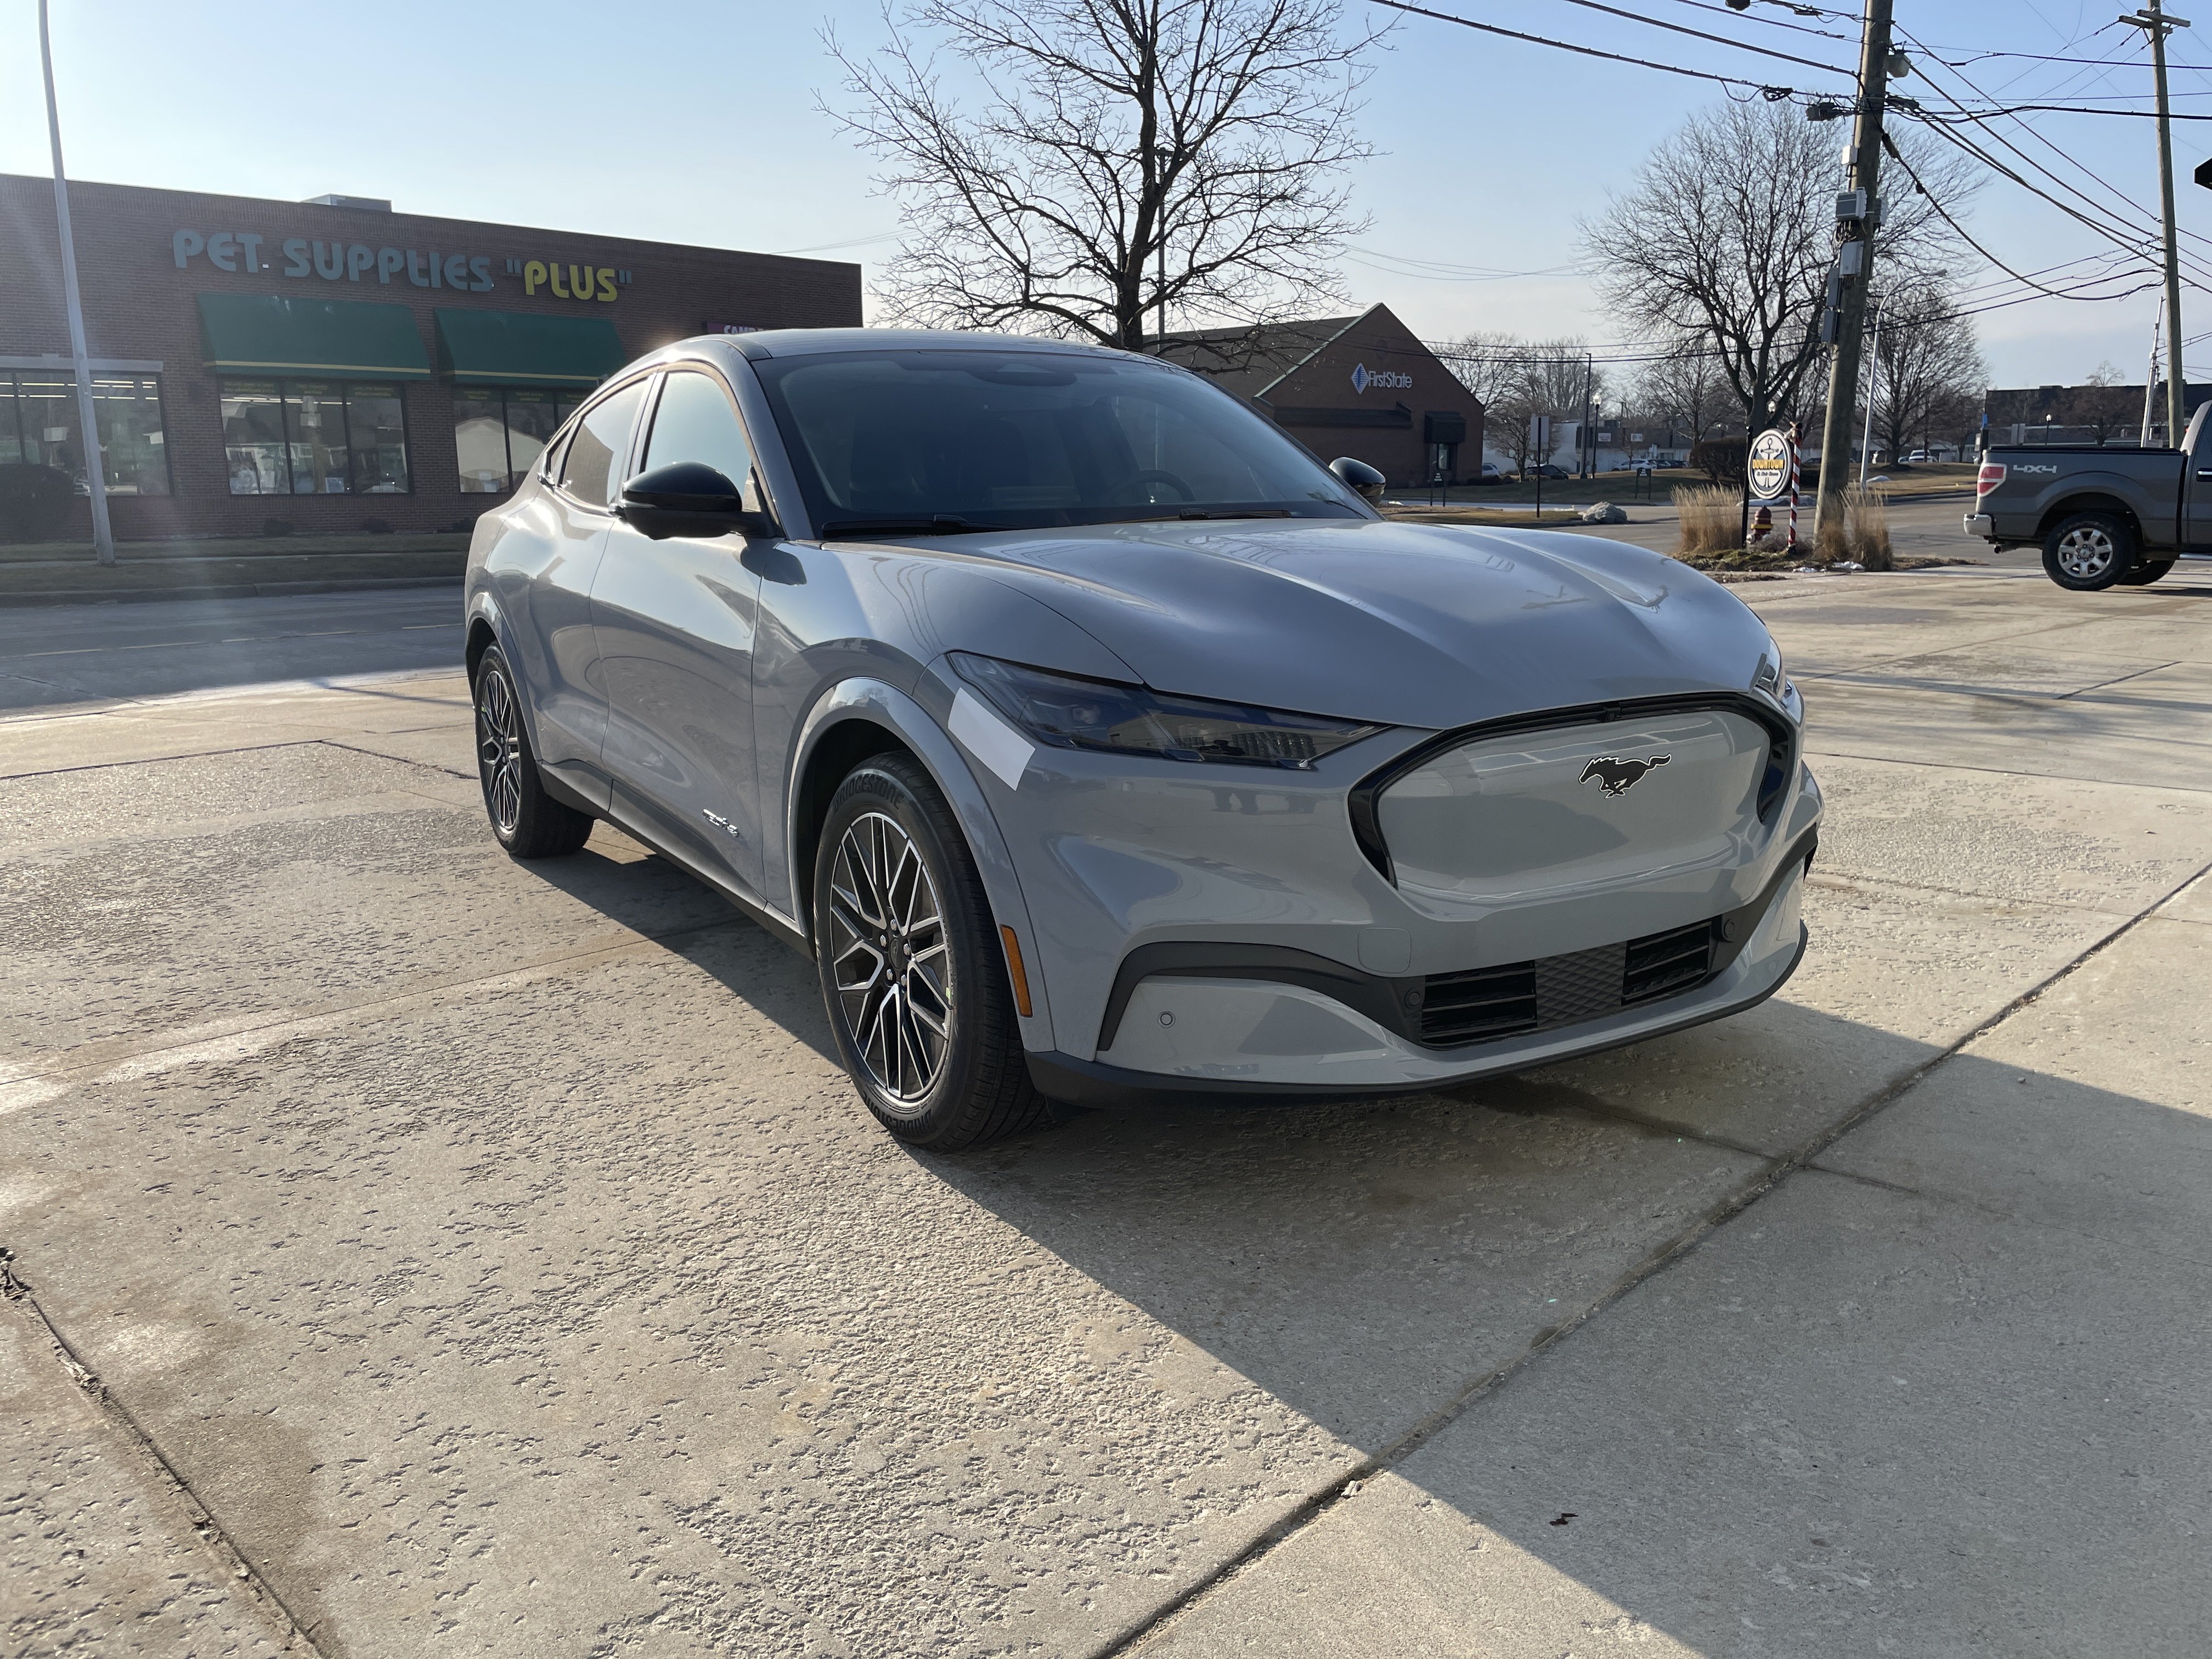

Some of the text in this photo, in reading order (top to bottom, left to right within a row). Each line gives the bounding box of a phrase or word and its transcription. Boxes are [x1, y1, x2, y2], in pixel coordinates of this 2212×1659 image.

[173, 229, 263, 273] PET
[283, 238, 493, 292] SUPPLIES
[1368, 370, 1412, 388] FirstState
[1752, 459, 1784, 469] DOWNTOWN
[832, 774, 905, 811] BRIDGESTONE
